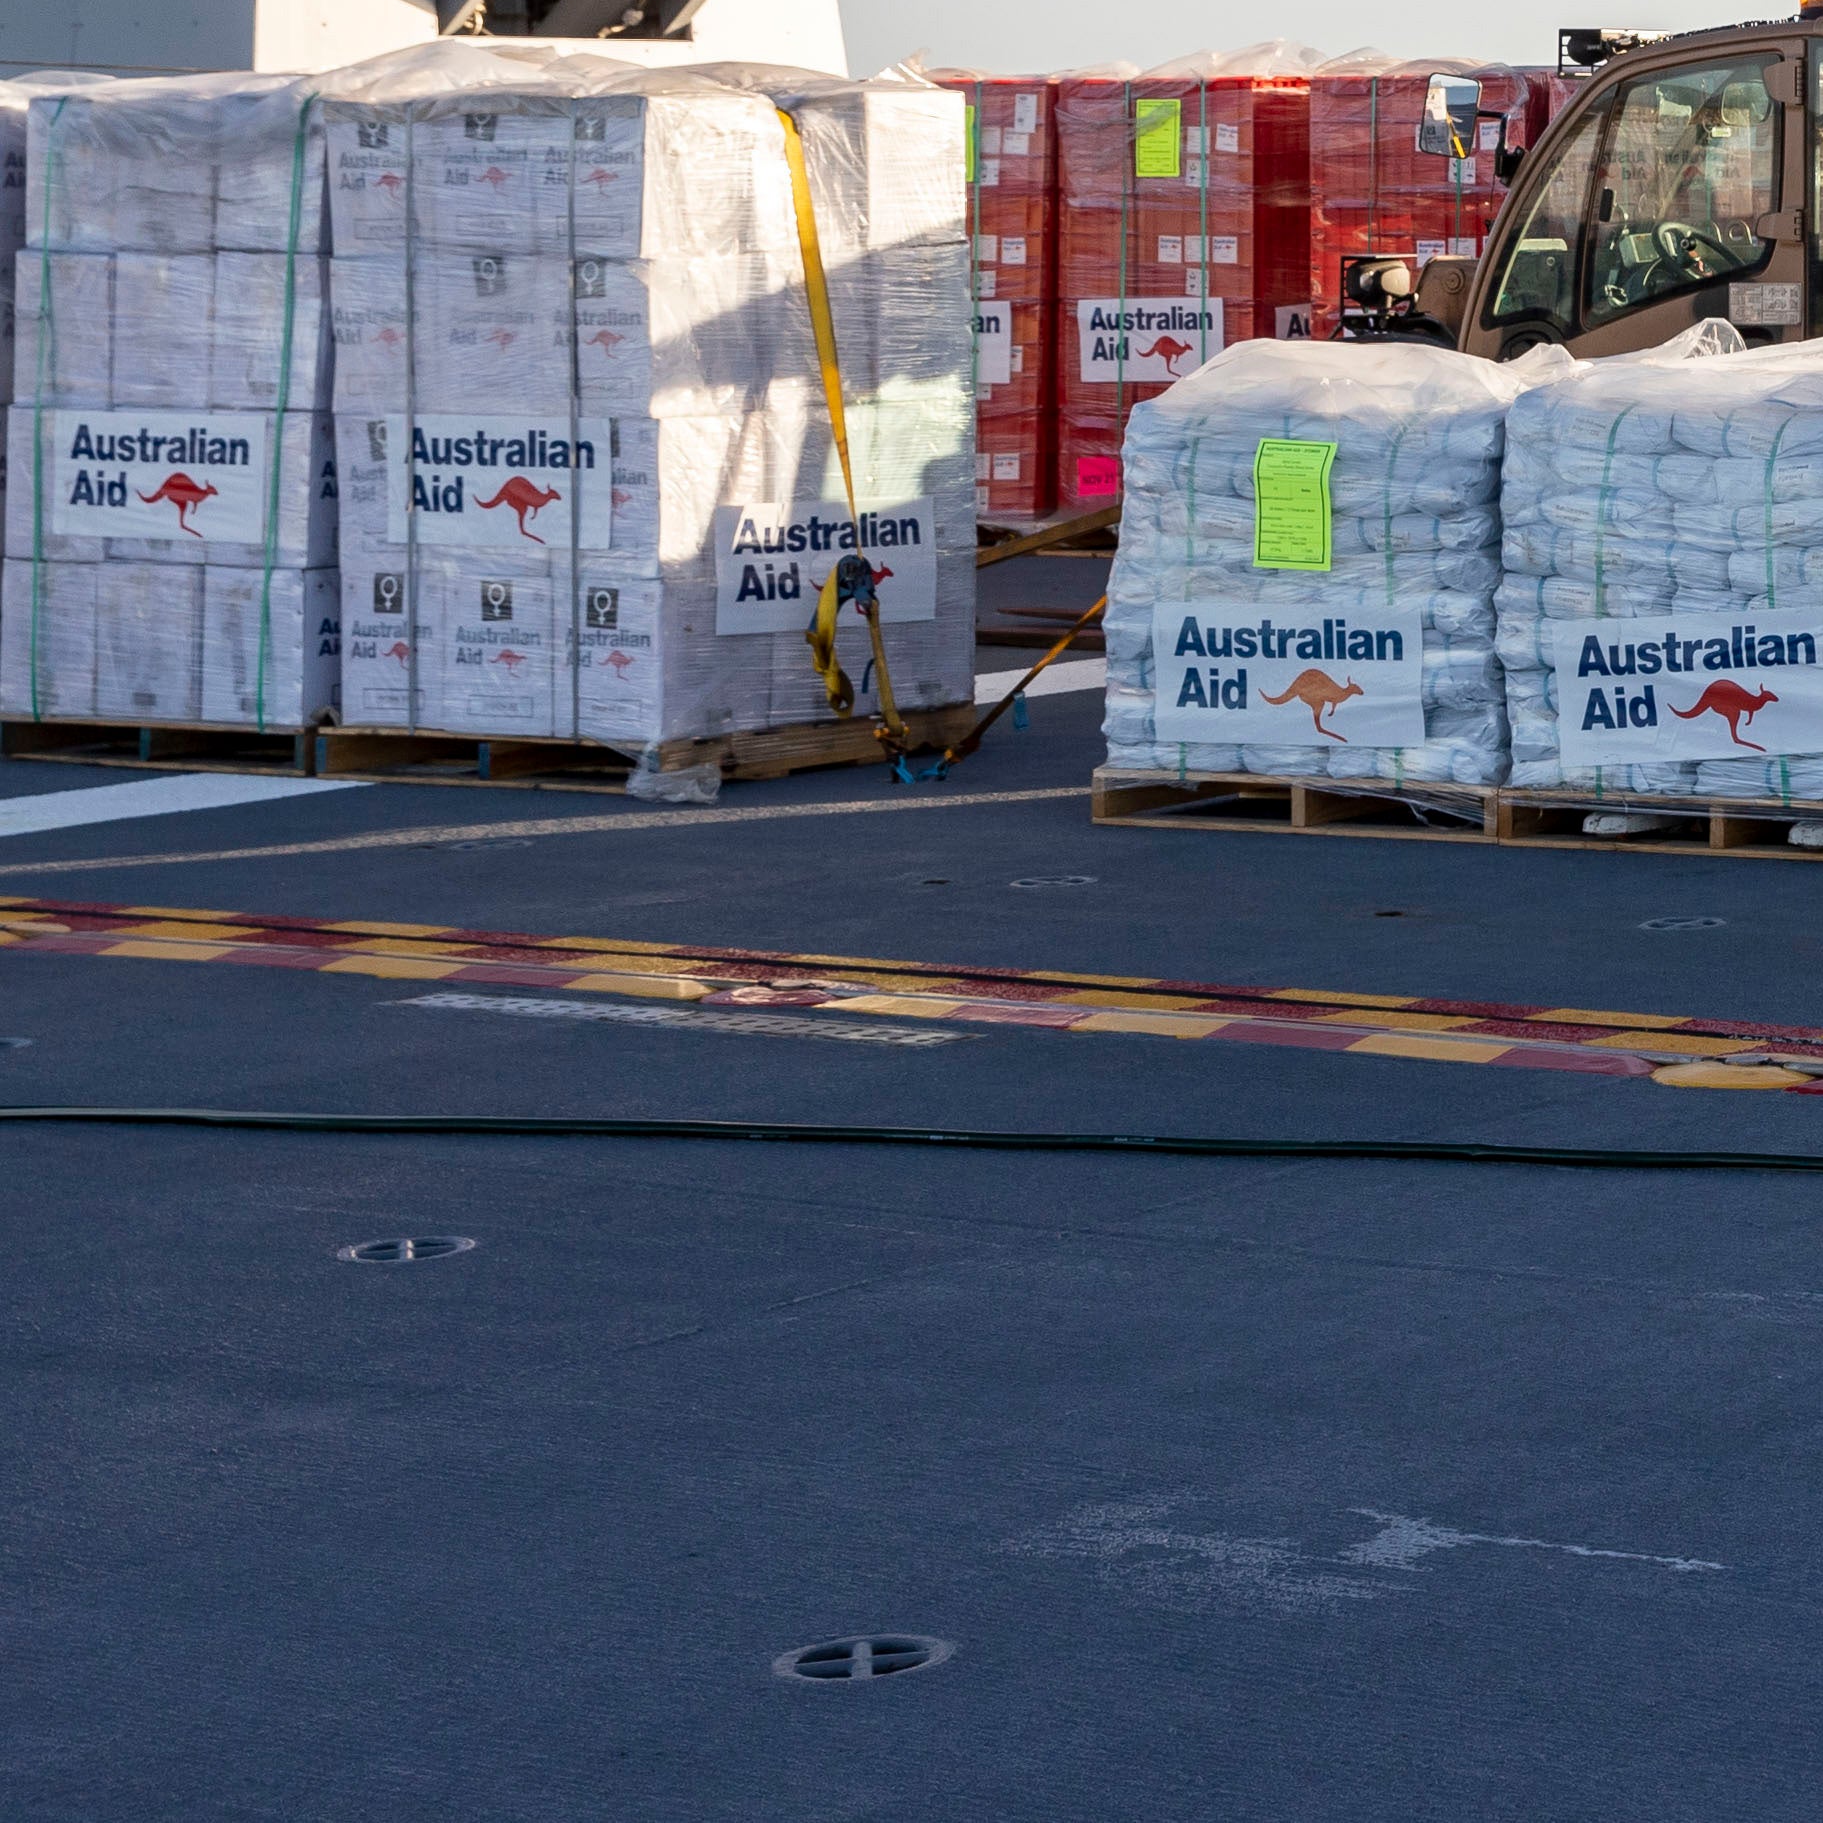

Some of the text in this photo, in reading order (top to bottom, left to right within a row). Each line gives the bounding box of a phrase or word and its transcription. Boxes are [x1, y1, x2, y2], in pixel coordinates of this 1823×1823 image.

[70, 424, 250, 466] Australian
[404, 427, 595, 469] Australian
[69, 469, 127, 507] Aid
[406, 475, 464, 513] Aid
[733, 512, 921, 555] Australian
[735, 562, 800, 603] Aid
[456, 647, 482, 665] Aid
[1174, 616, 1404, 661] Australian
[1577, 625, 1817, 677] Australian
[1176, 667, 1247, 710] Aid
[1581, 684, 1658, 731] Aid
